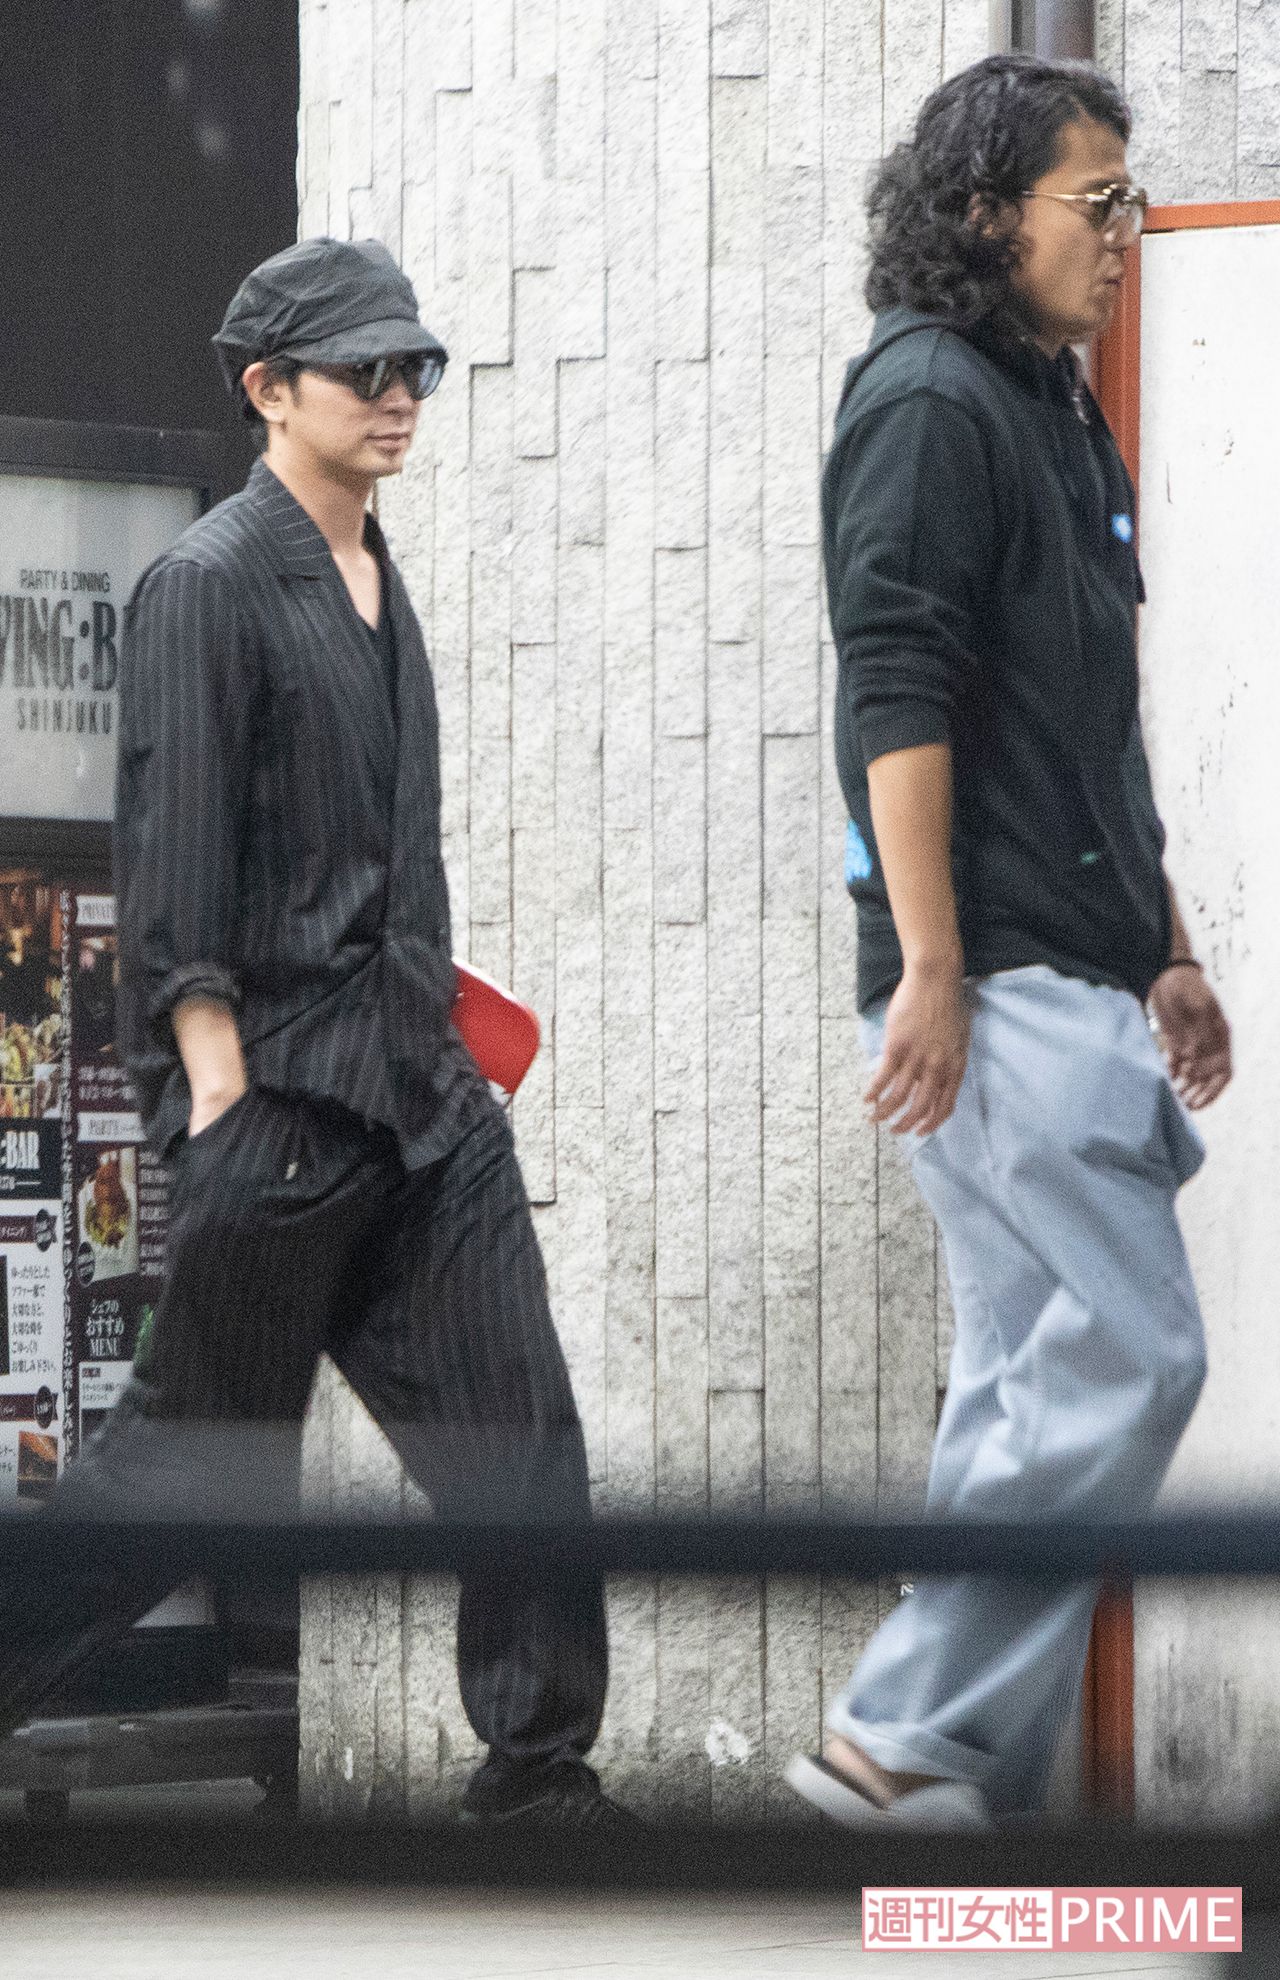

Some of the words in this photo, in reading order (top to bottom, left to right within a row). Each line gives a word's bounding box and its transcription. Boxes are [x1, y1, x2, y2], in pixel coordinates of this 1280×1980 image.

[20, 569, 58, 588] PARTY
[61, 572, 68, 590] &
[72, 571, 110, 592] DINING
[17, 697, 112, 734] SHINJUKU
[85, 1314, 125, 1338] おすすめ
[89, 1337, 120, 1358] MENU
